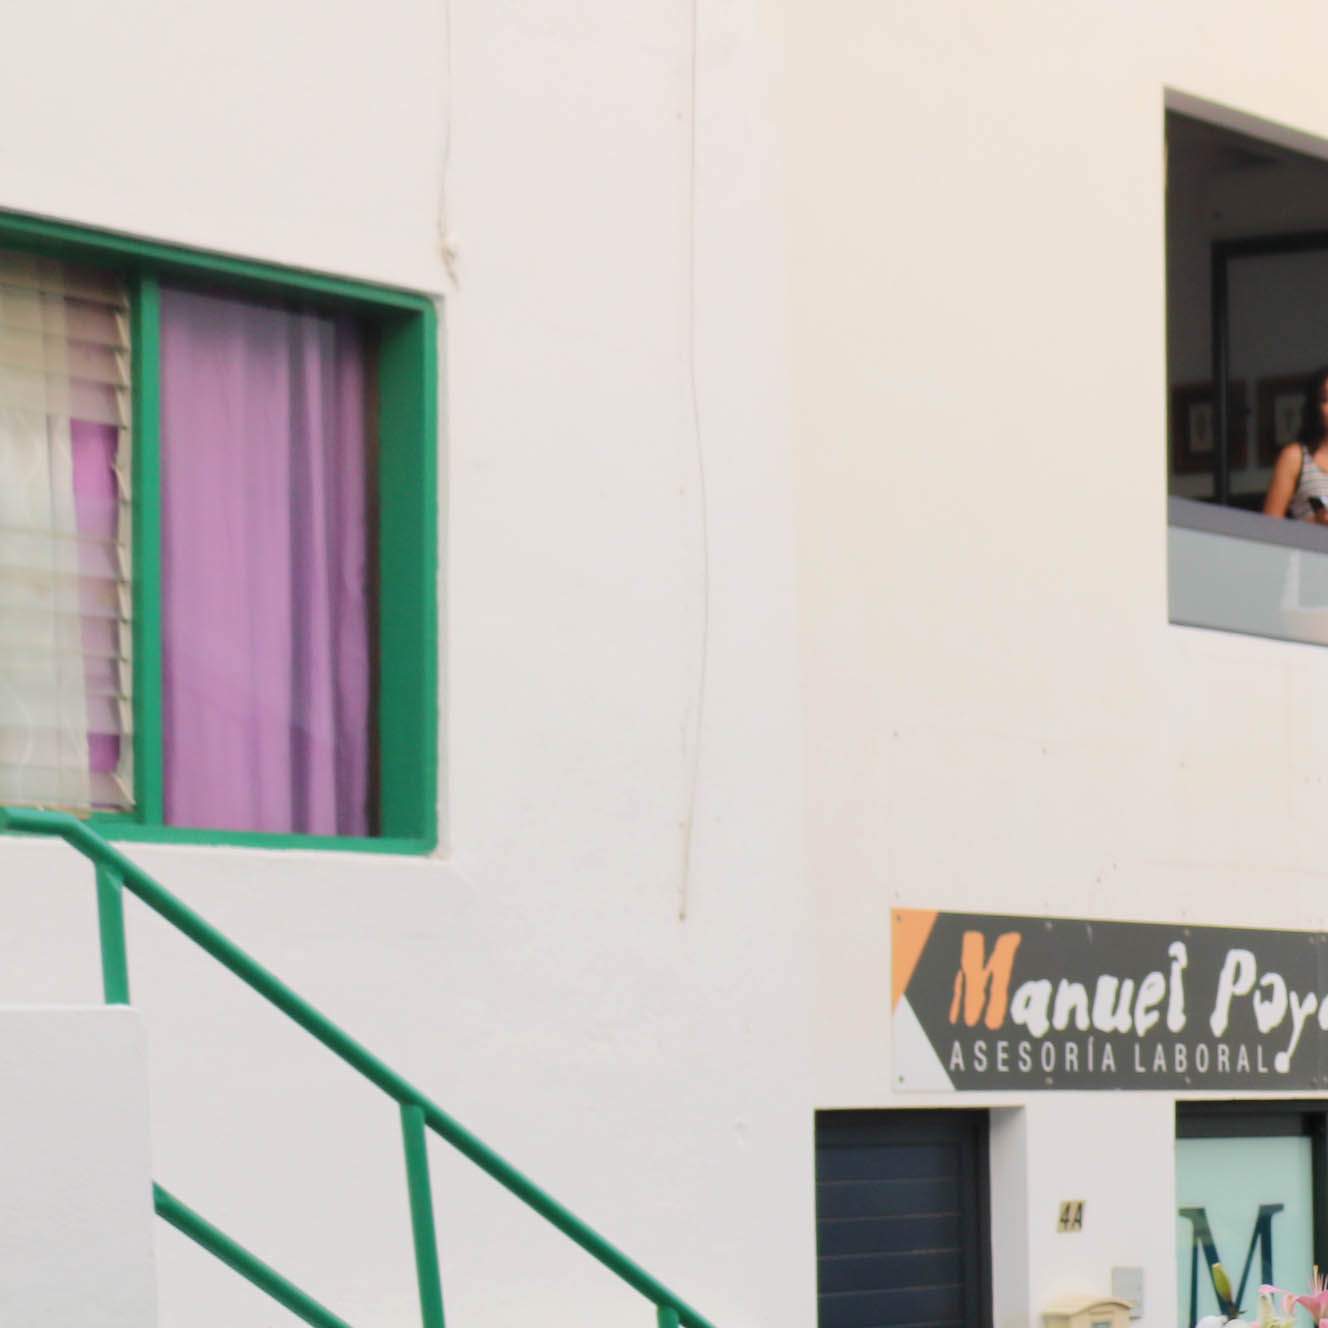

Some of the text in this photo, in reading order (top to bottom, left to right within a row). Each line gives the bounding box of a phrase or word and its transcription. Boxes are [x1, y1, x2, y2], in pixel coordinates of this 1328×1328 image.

[949, 930, 1188, 1038] Manuel
[949, 1036, 1270, 1075] ASESORÍA LABORAL
[1060, 1201, 1083, 1231] 4A
